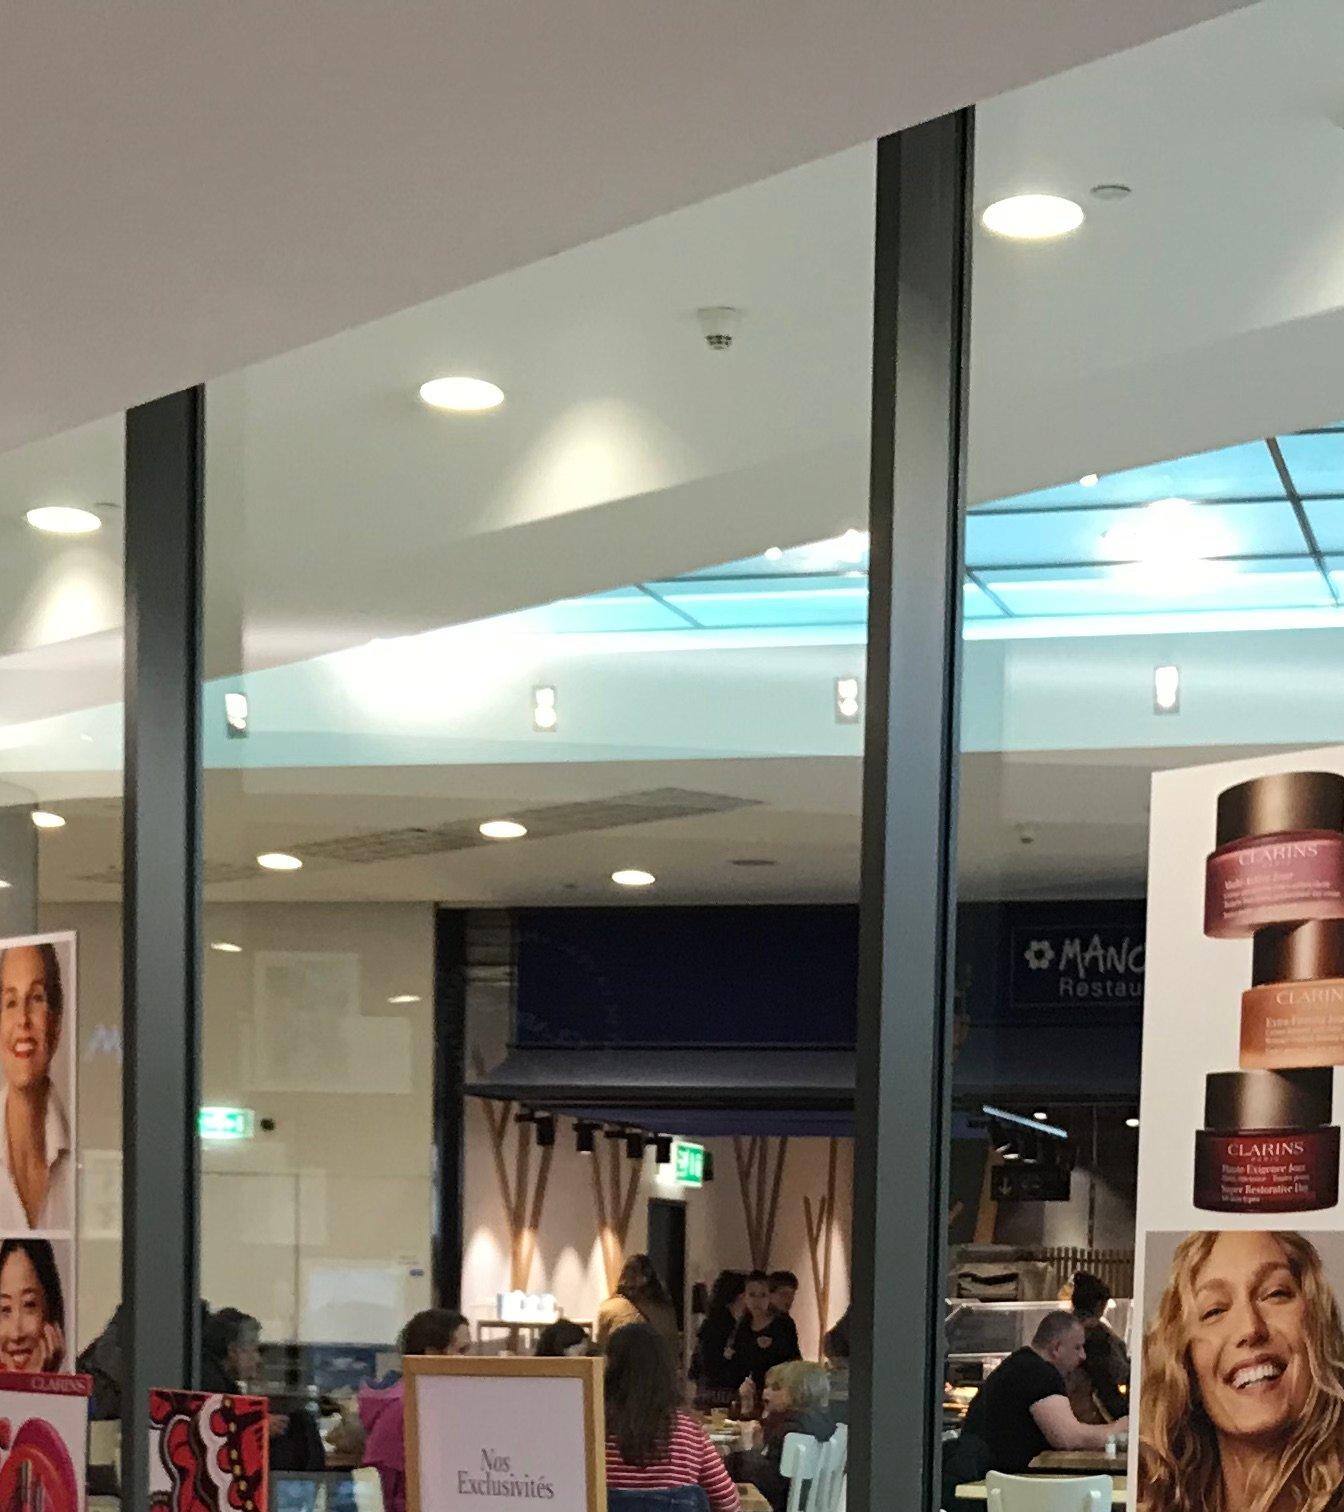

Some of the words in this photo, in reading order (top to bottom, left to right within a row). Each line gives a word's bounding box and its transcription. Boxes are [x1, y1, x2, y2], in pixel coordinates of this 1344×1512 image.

[1239, 844, 1318, 866] CLARINS
[1059, 933, 1146, 979] MANO
[1059, 977, 1142, 998] Restau
[1227, 1141, 1304, 1156] CLARINS
[480, 1448, 511, 1472] Nos
[457, 1470, 555, 1500] Exclusivités
